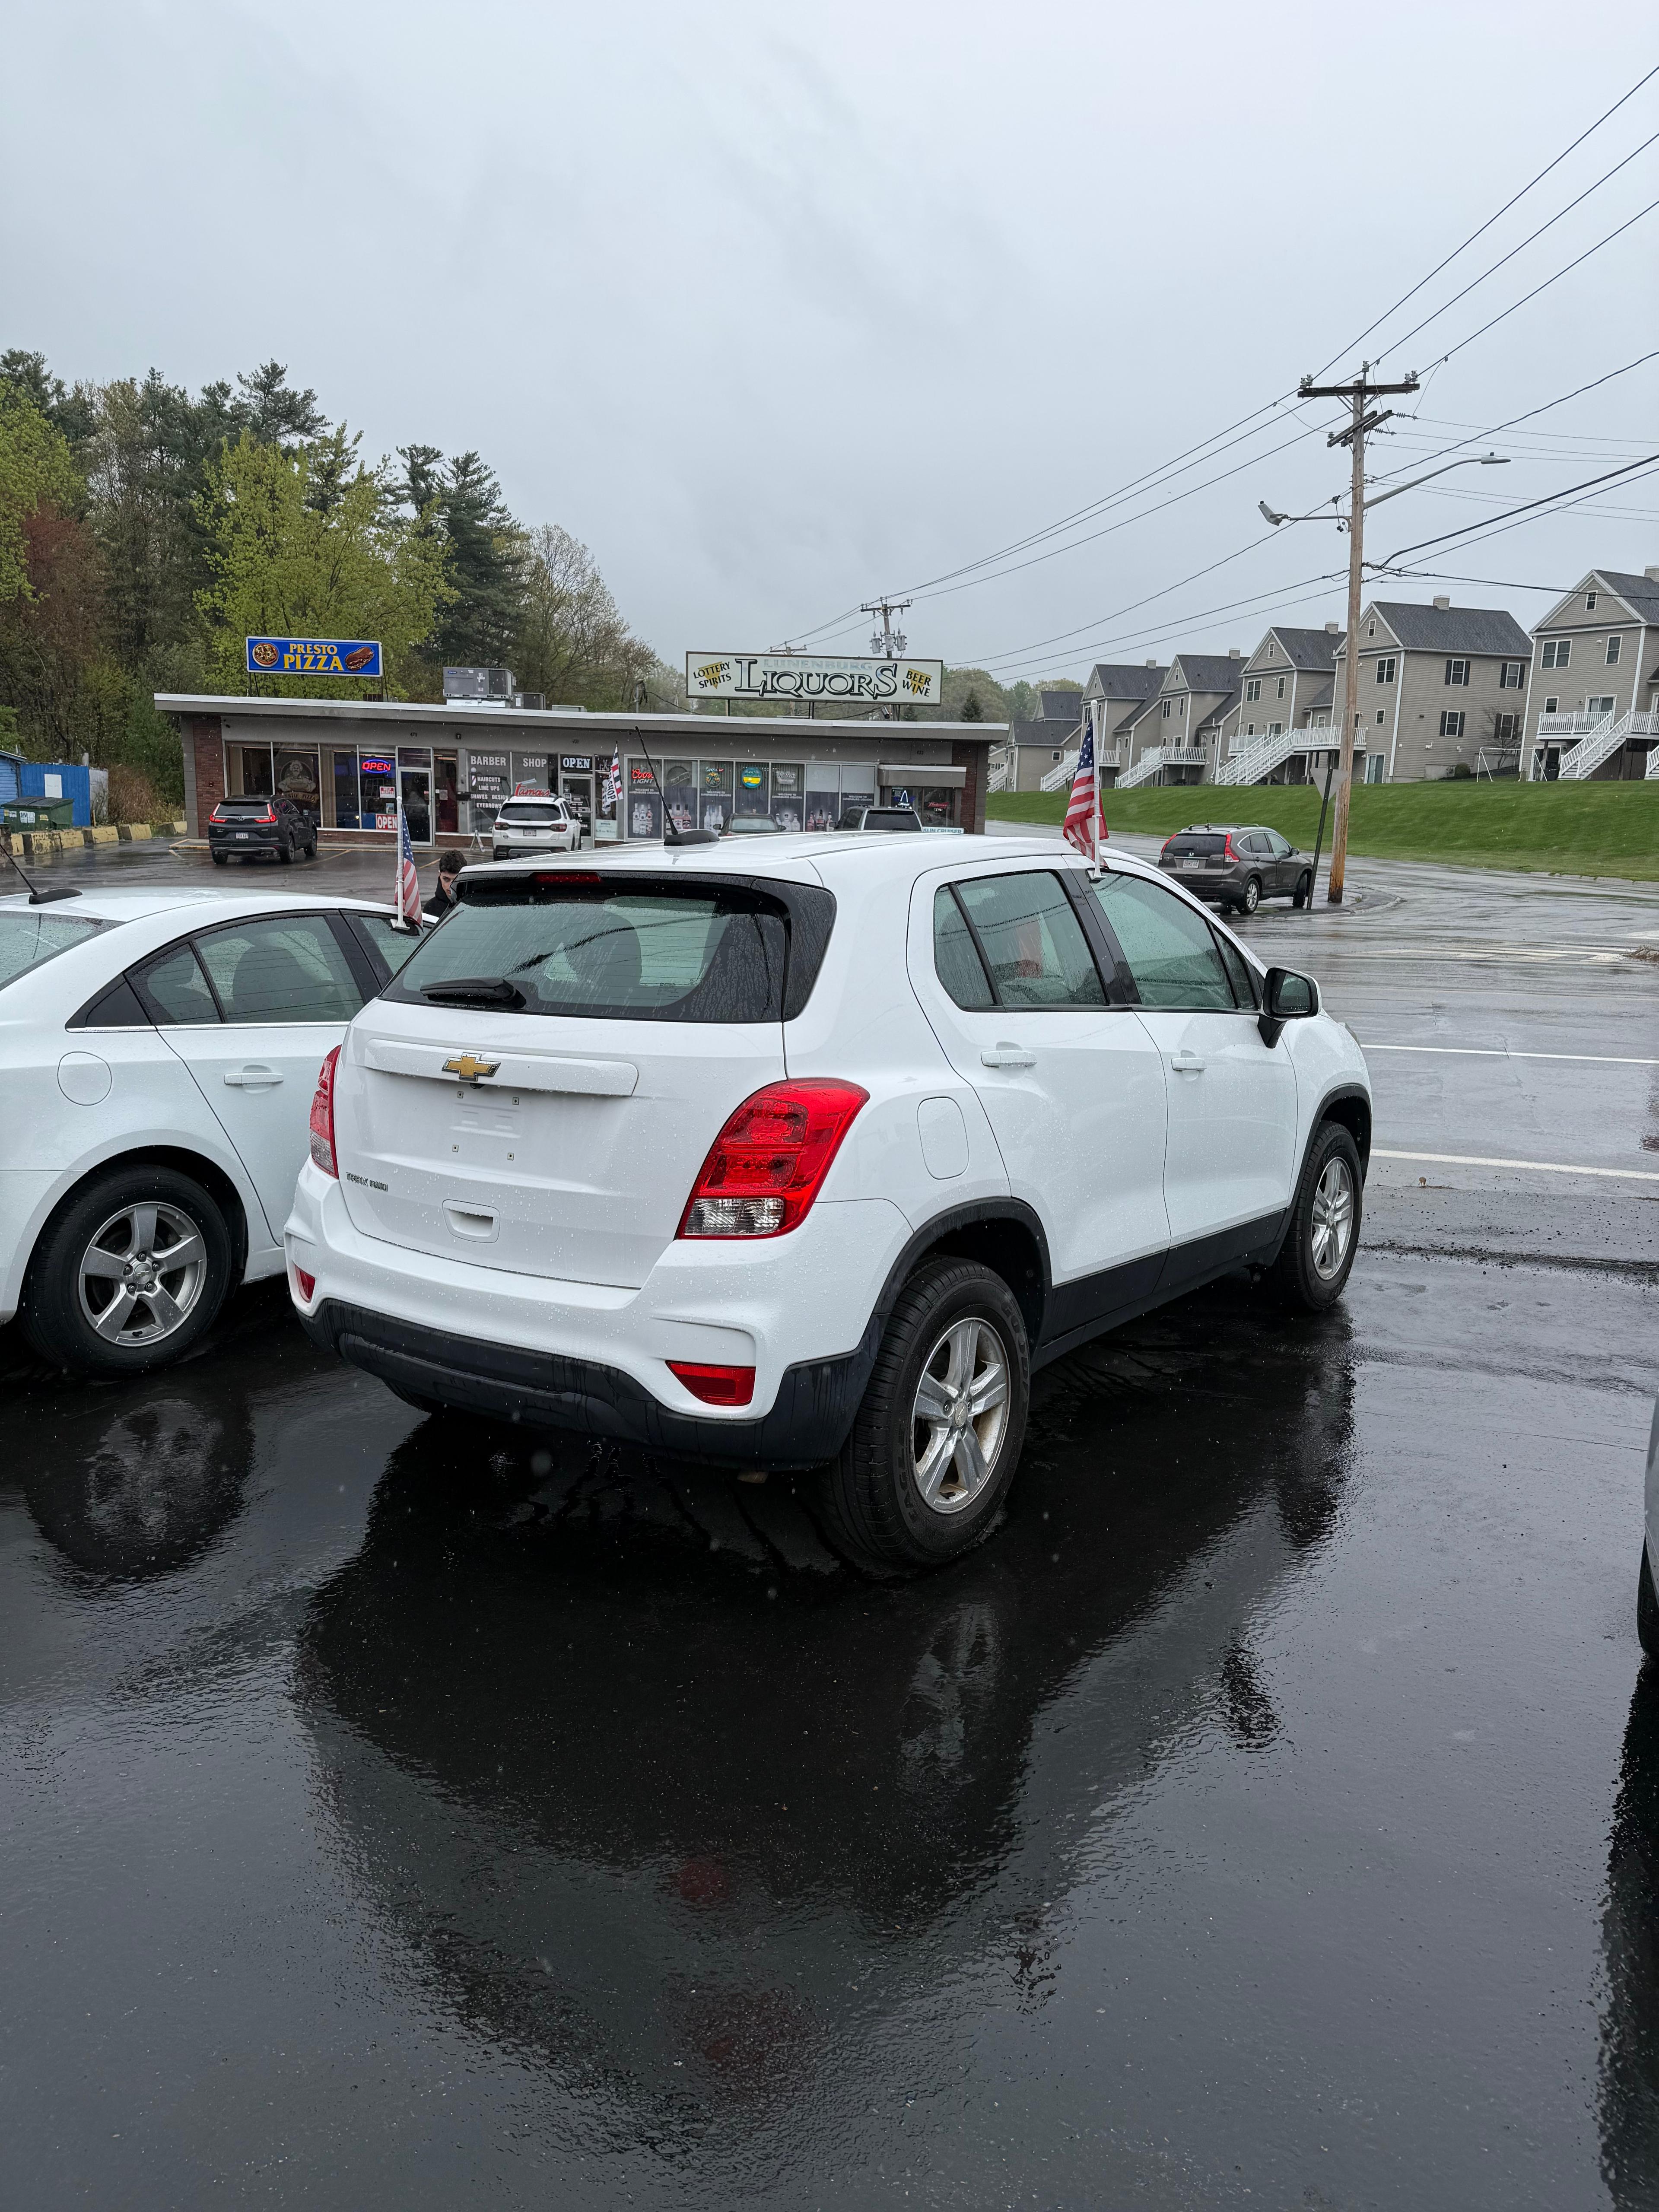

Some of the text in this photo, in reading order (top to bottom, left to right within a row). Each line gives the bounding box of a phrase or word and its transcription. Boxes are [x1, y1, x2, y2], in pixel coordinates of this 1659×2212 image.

[289, 643, 337, 655] PRESTO
[283, 654, 344, 671] PIZZA
[763, 659, 872, 670] LUNENBURG
[693, 661, 730, 679] LOTTERY
[699, 673, 731, 688] SPIRITS
[735, 659, 897, 699] LIQUORS
[906, 670, 931, 686] BEER
[903, 680, 930, 697] WINE
[362, 762, 391, 771] OPEN
[470, 756, 547, 767] BARBER SHOP
[563, 757, 590, 768] OPEN
[377, 816, 397, 829] OPEN
[346, 1172, 368, 1186] TRAX
